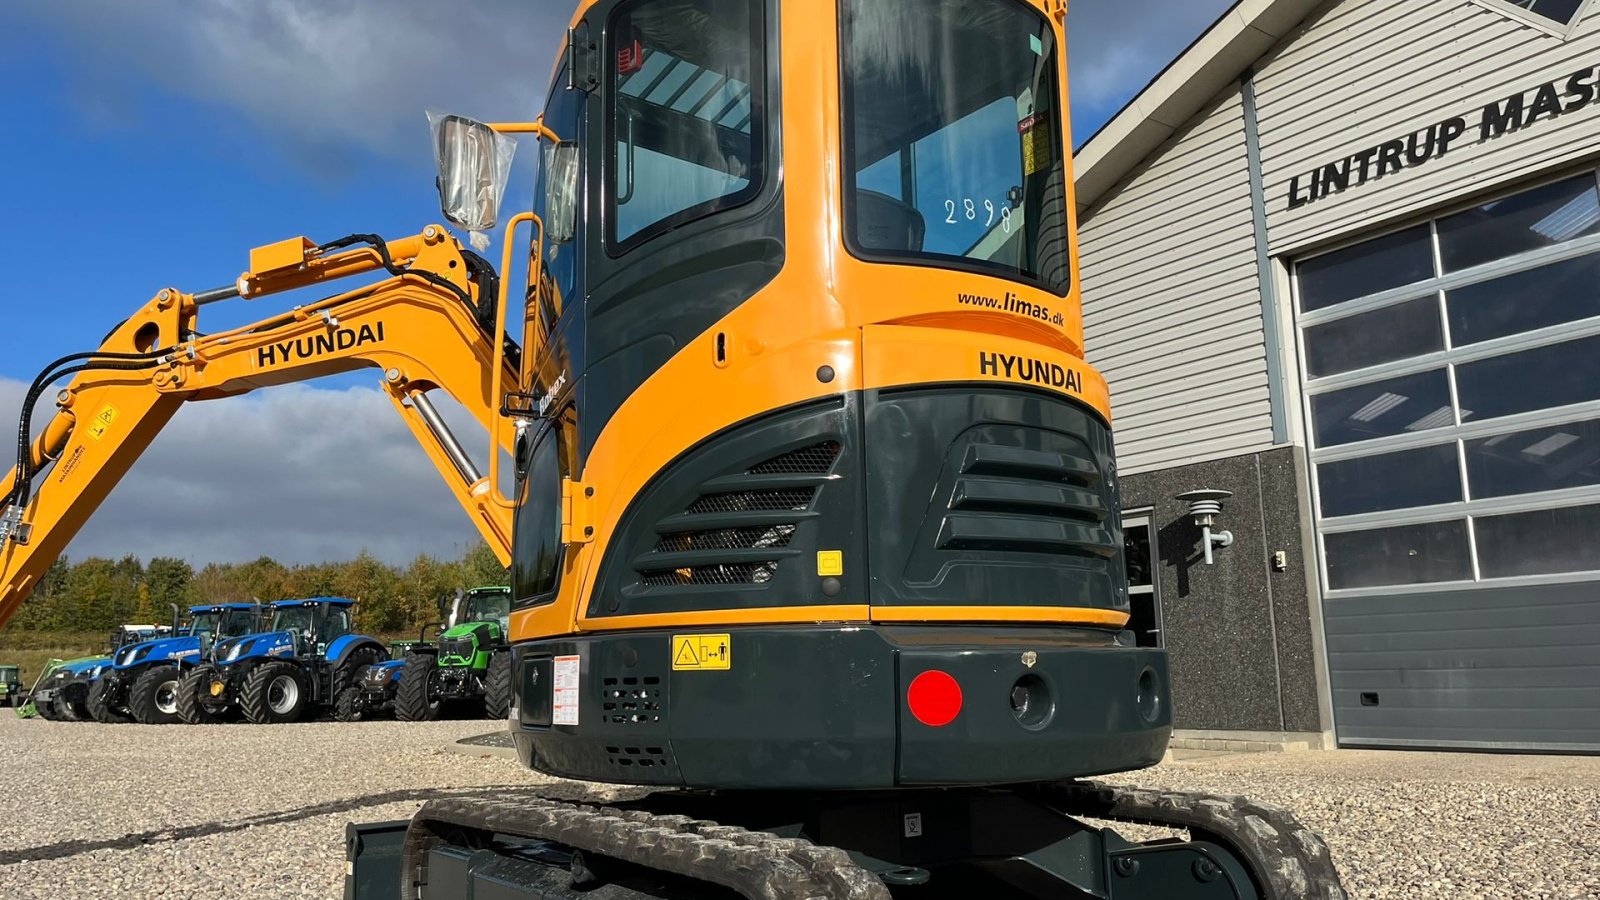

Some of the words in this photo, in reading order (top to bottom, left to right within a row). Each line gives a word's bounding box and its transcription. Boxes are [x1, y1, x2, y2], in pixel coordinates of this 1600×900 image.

[1287, 116, 1466, 211] LINTRUP
[1477, 68, 1600, 145] MAS
[945, 199, 1010, 233] 2898
[958, 292, 1064, 327] www.limas.dk
[258, 321, 384, 367] HYUNDAI
[980, 351, 1082, 393] HYUNDAI
